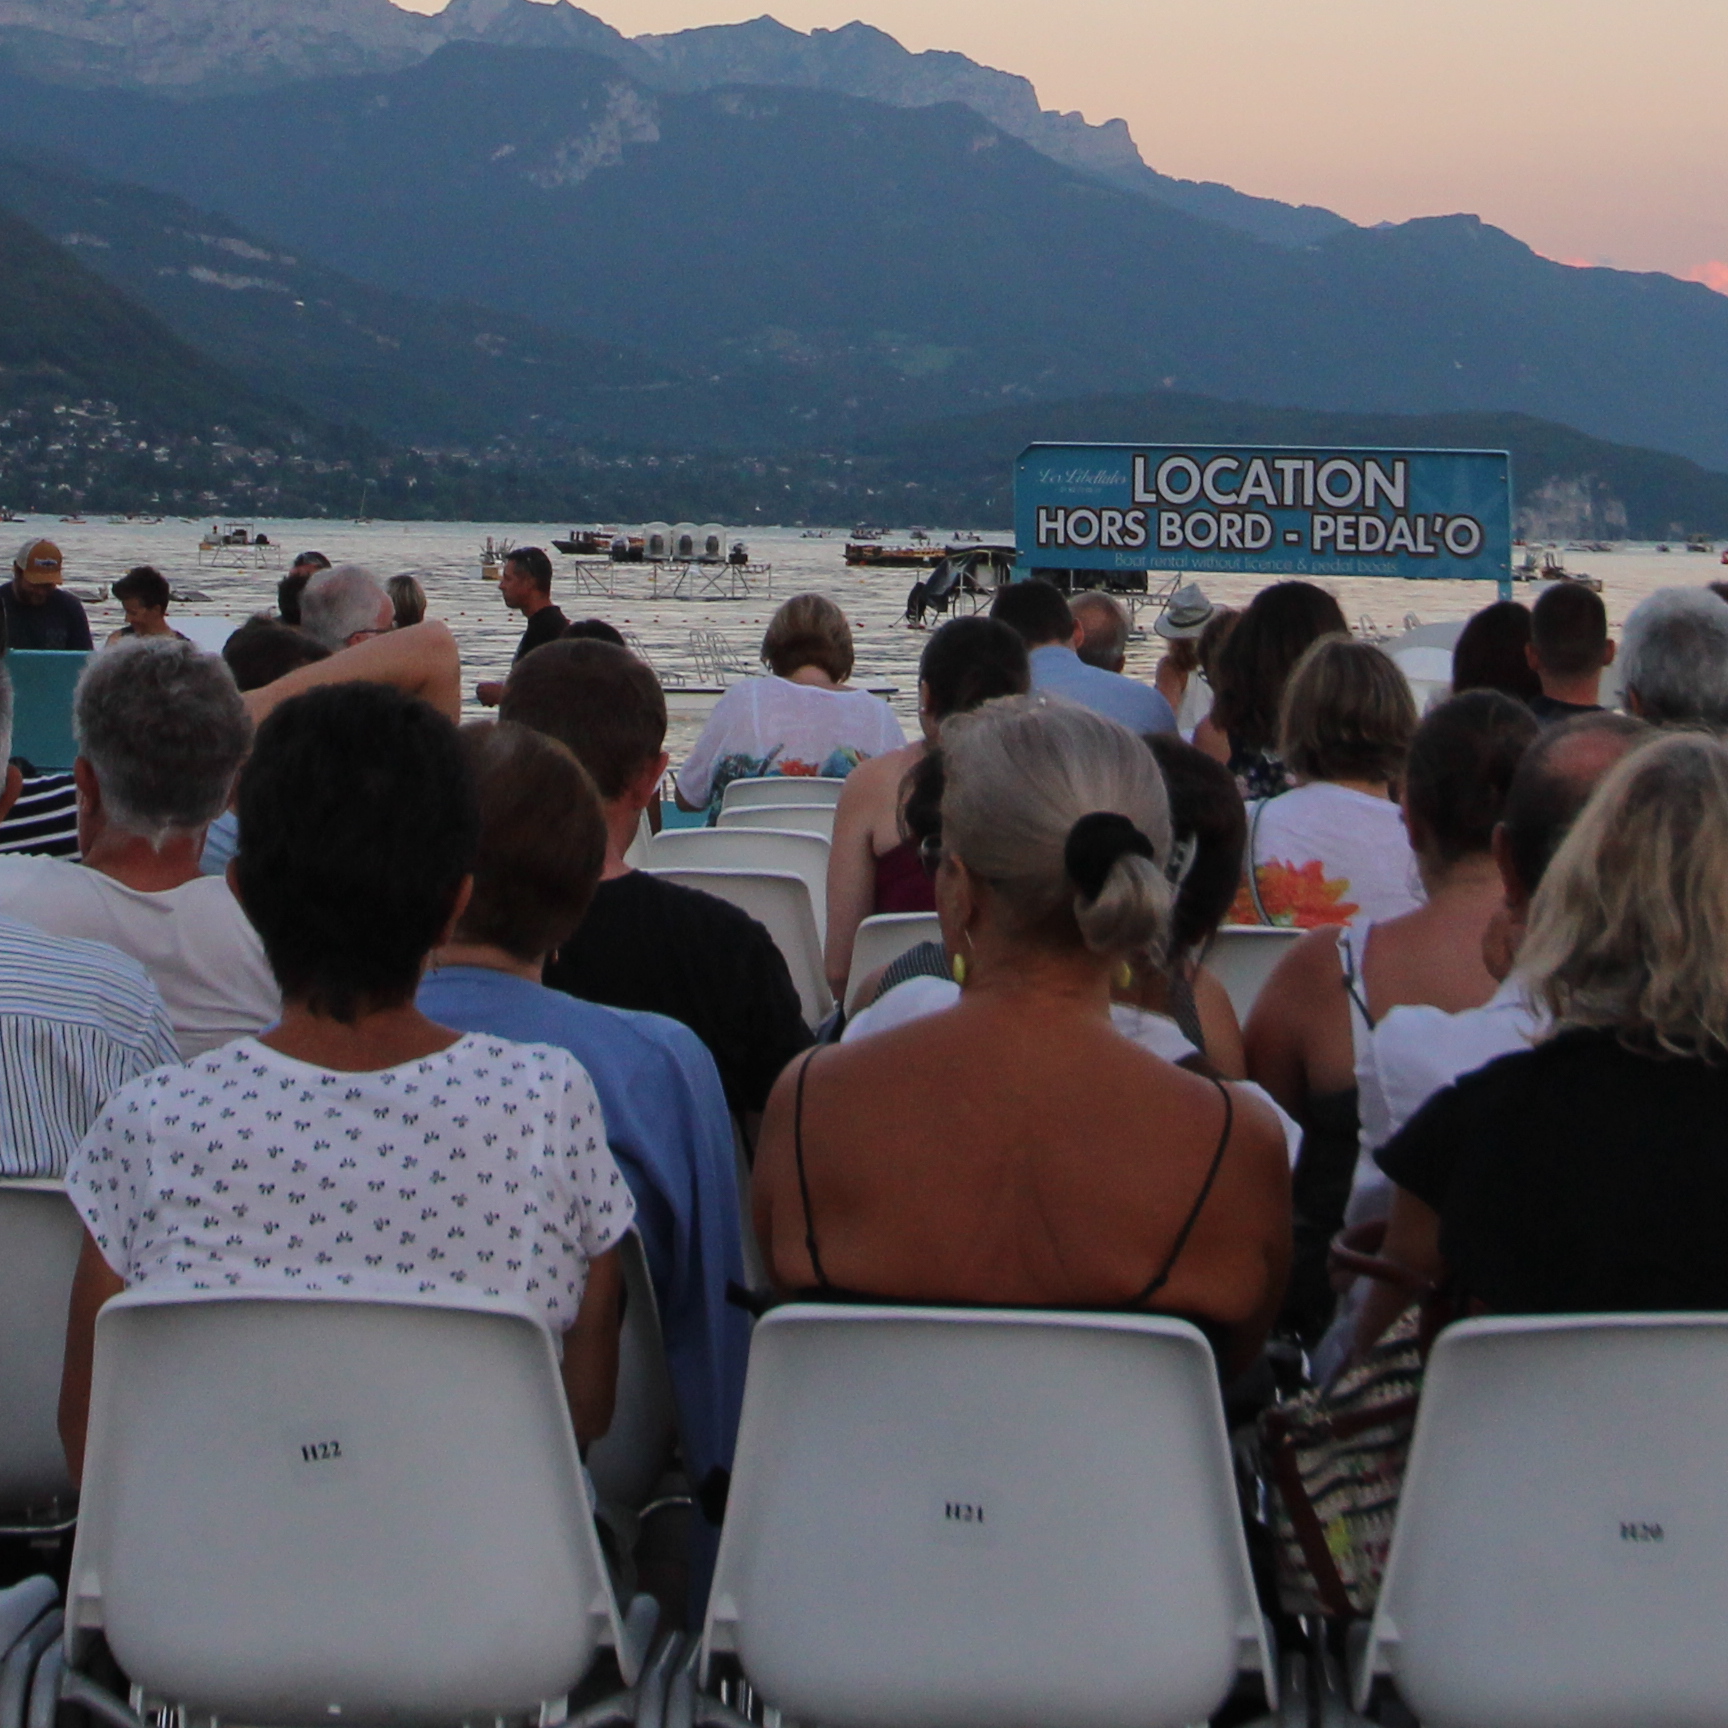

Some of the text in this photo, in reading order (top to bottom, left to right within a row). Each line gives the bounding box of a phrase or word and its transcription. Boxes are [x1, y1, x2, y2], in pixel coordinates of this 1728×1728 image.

[1133, 455, 1406, 509] LOCATION
[1037, 508, 1147, 548] HORS
[1159, 510, 1273, 550] BORD
[1312, 513, 1481, 555] PEDAL'O
[1114, 552, 1147, 567] Boat
[1149, 554, 1188, 568] rental
[1191, 555, 1241, 570] without
[1244, 556, 1293, 571] licence
[1311, 558, 1354, 574] pedal
[1357, 558, 1399, 573] boats
[301, 1441, 342, 1462] H22
